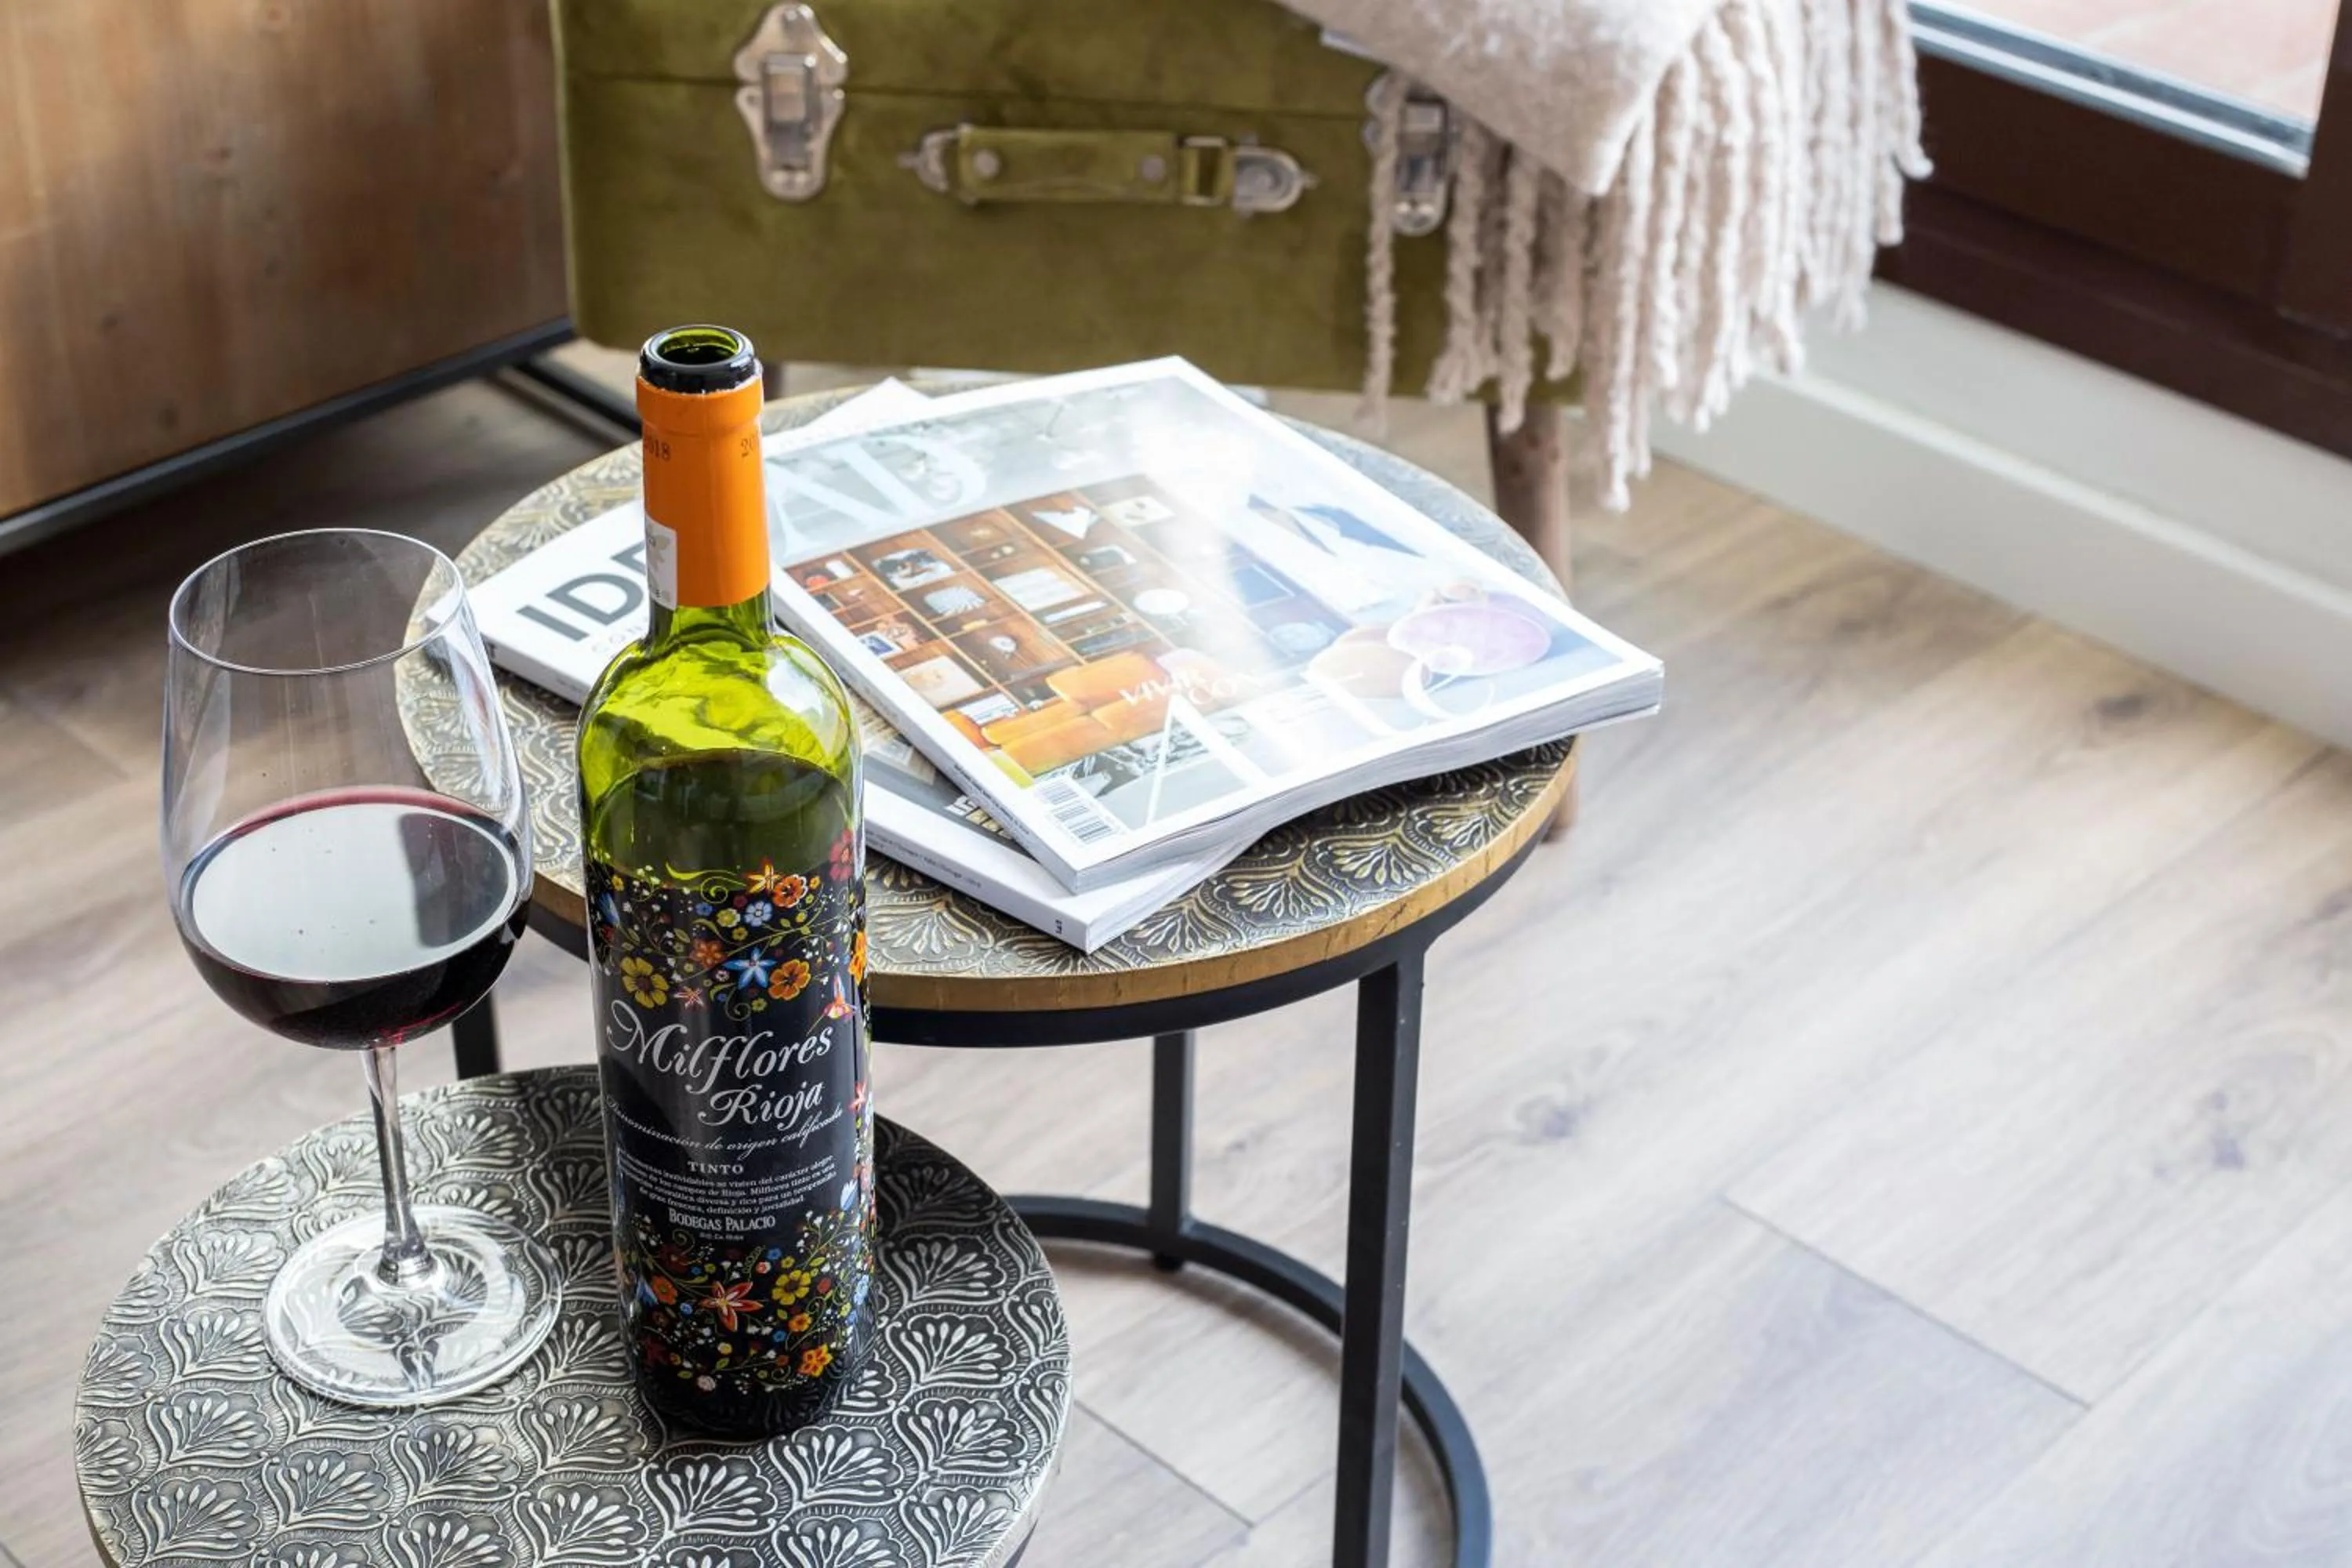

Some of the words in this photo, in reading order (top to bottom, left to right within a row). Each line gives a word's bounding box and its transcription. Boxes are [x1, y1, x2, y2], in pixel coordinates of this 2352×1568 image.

[644, 434, 672, 463] 018
[765, 434, 986, 559] AD
[606, 1000, 833, 1094] Milflores
[698, 1080, 825, 1131] Rioja
[705, 1135, 723, 1150] de
[727, 1138, 778, 1161] origen
[687, 1161, 744, 1174] TINTO
[668, 1207, 722, 1231] BODEGAS
[724, 1215, 776, 1232] PALACIO
